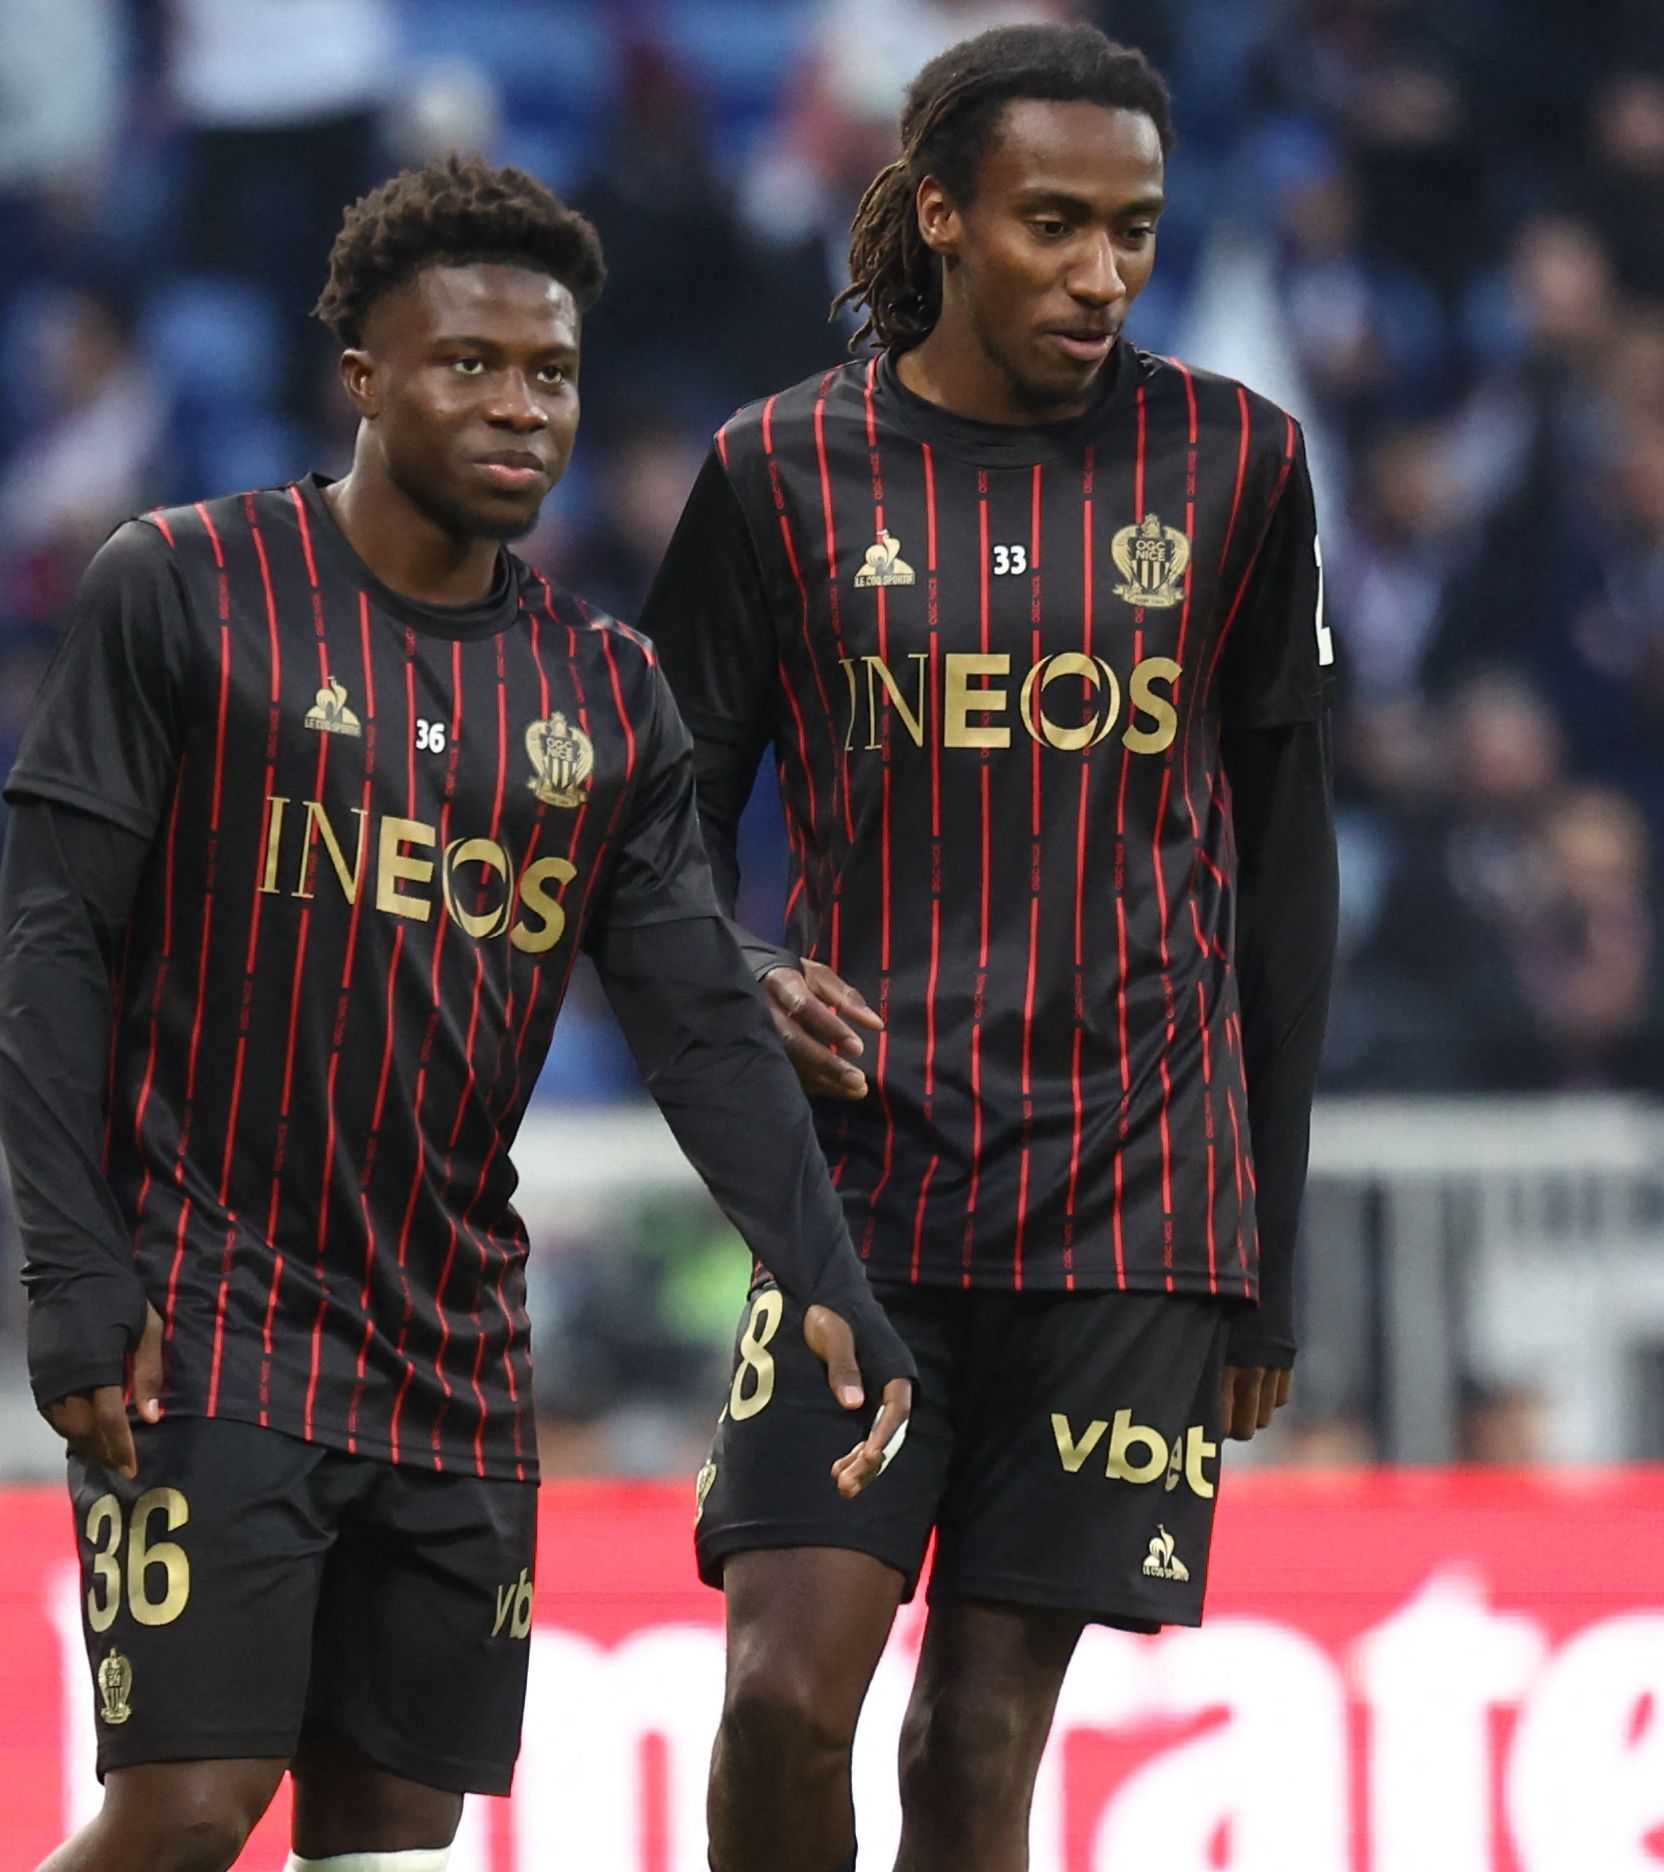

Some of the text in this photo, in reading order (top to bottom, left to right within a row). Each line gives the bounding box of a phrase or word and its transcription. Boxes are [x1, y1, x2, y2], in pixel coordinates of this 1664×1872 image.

[993, 545, 1027, 576] 33
[1136, 540, 1166, 552] OGC
[1136, 551, 1166, 562] NICE
[838, 652, 1183, 755] INEOS
[416, 719, 446, 753] 36
[257, 795, 578, 953] INEOS
[86, 1487, 190, 1633] 36
